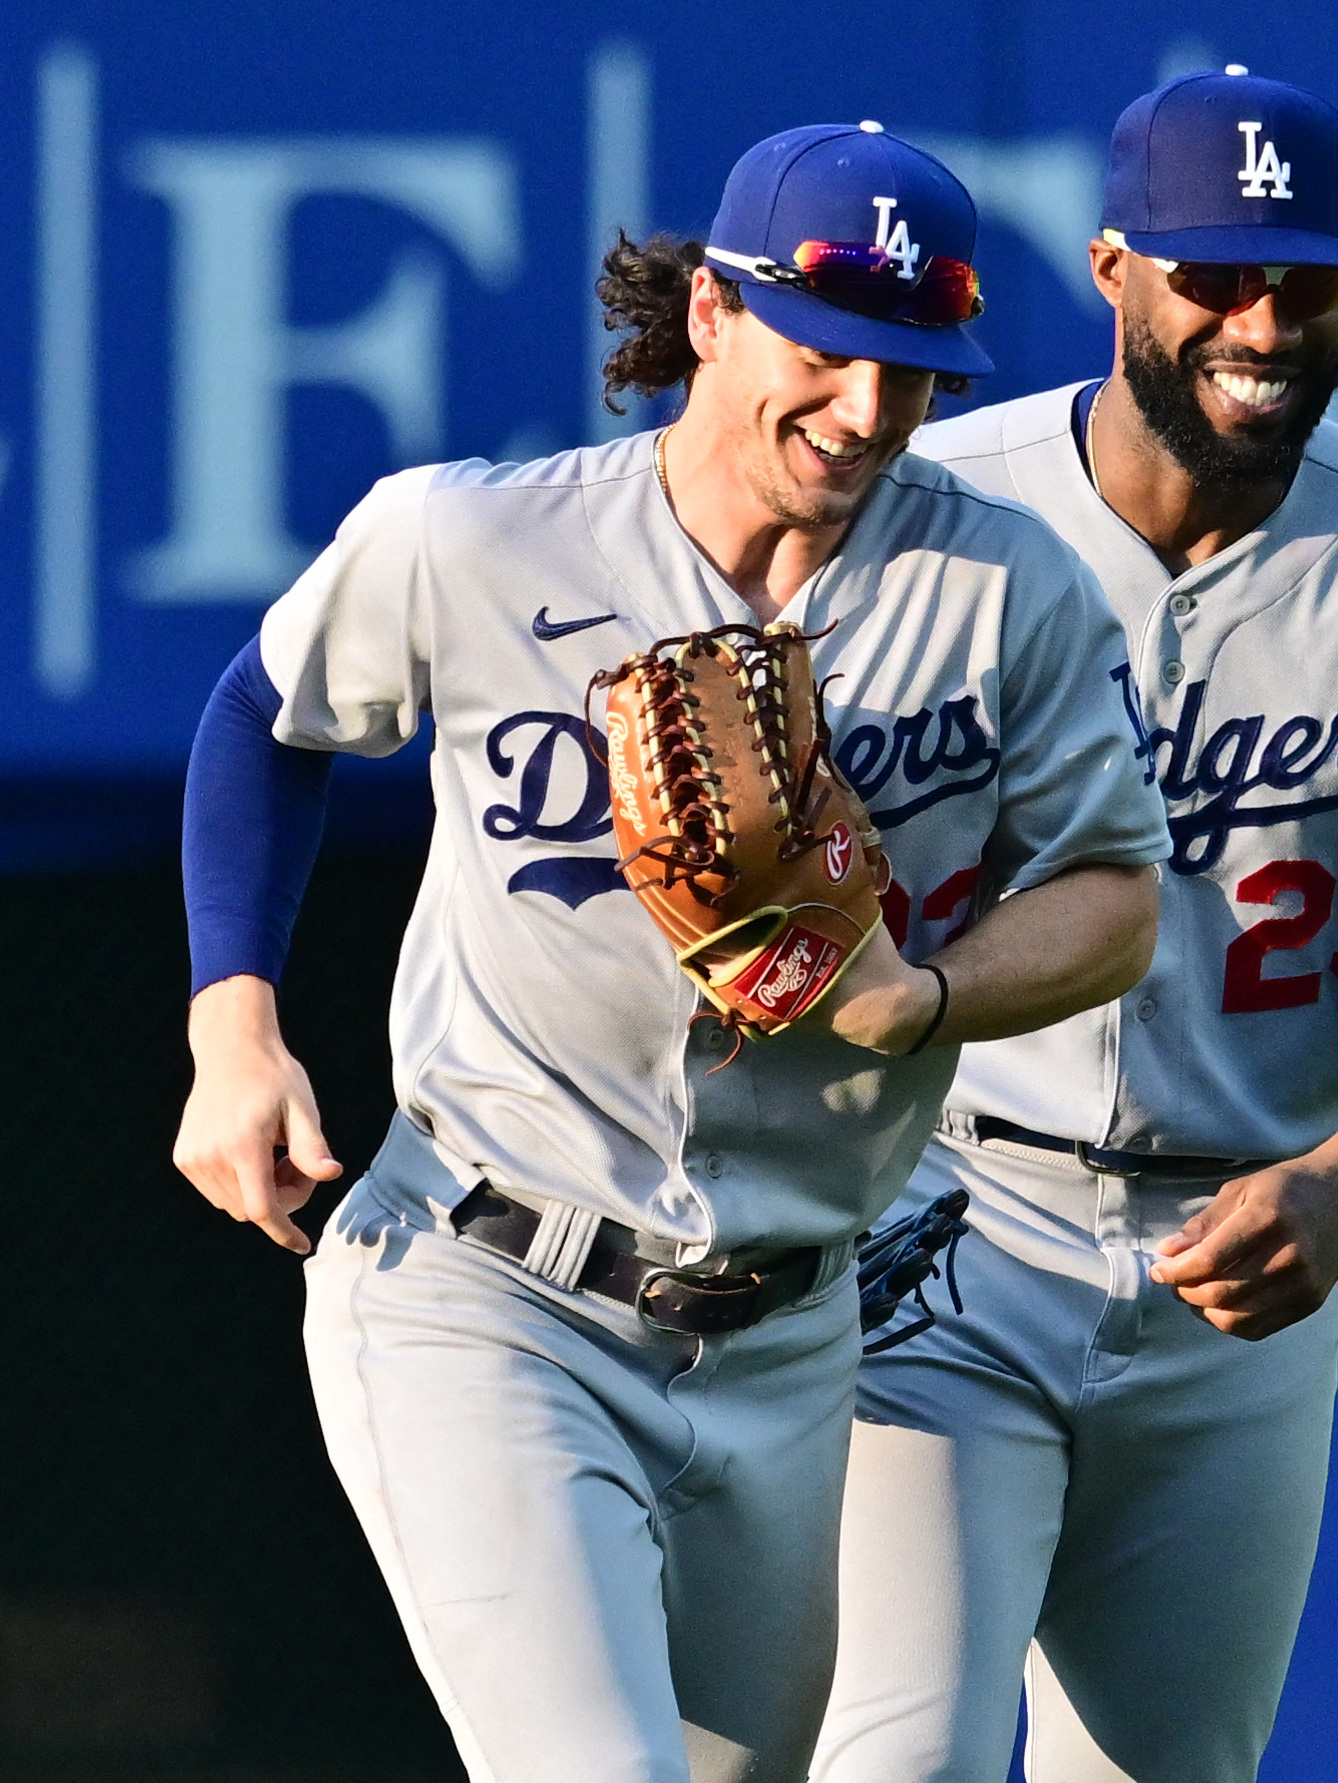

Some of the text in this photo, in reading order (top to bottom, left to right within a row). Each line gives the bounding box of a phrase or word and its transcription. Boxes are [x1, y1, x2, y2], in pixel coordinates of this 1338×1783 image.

[1237, 121, 1292, 200] LA
[872, 196, 921, 280] LA
[483, 695, 1001, 850] Ders
[606, 711, 647, 837] Rawlings
[757, 937, 812, 1008] Rawlings
